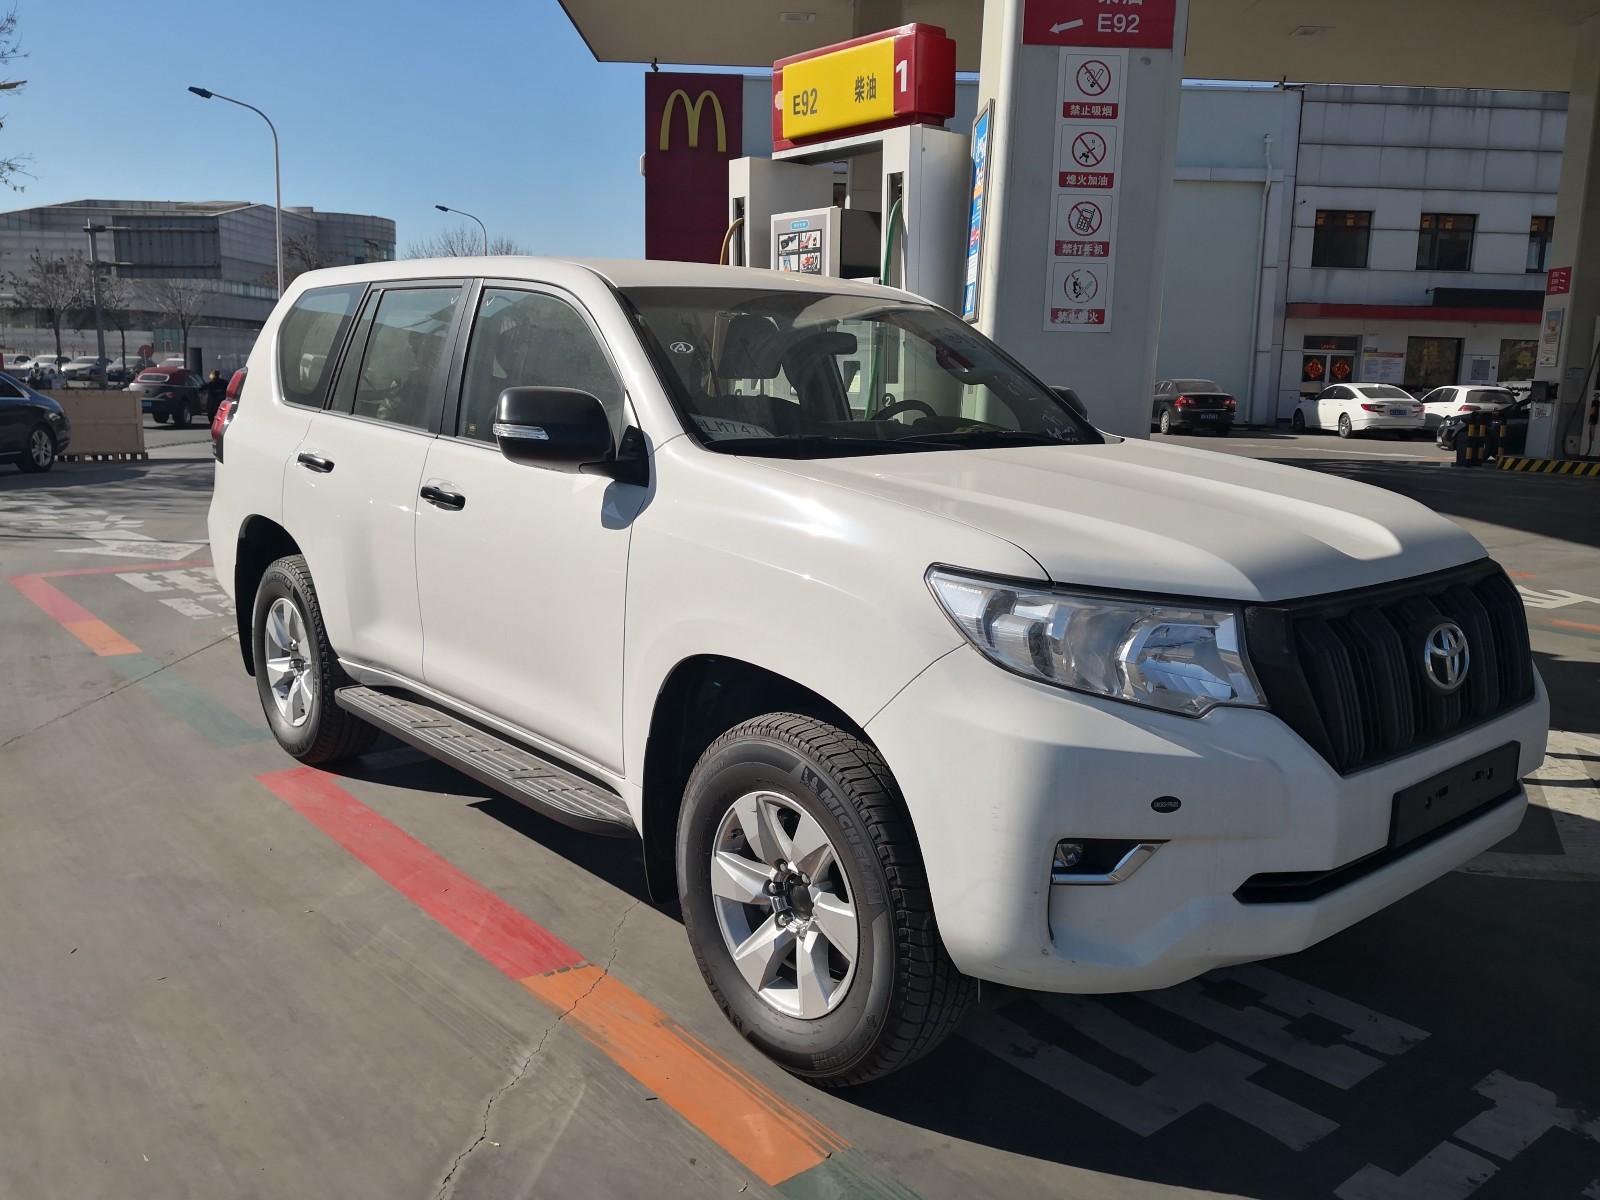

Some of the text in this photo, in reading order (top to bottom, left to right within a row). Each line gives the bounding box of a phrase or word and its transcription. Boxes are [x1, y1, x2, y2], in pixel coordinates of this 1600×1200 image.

[1097, 13, 1140, 33] E92
[895, 60, 908, 93] 1
[854, 73, 877, 104] 柴油
[792, 88, 818, 116] E92
[1070, 104, 1113, 117] 禁止吸烟
[1066, 174, 1108, 186] 熄火加油
[1062, 242, 1104, 255] 禁打手机
[885, 395, 892, 407] 2
[818, 787, 882, 905] MICHELIN
